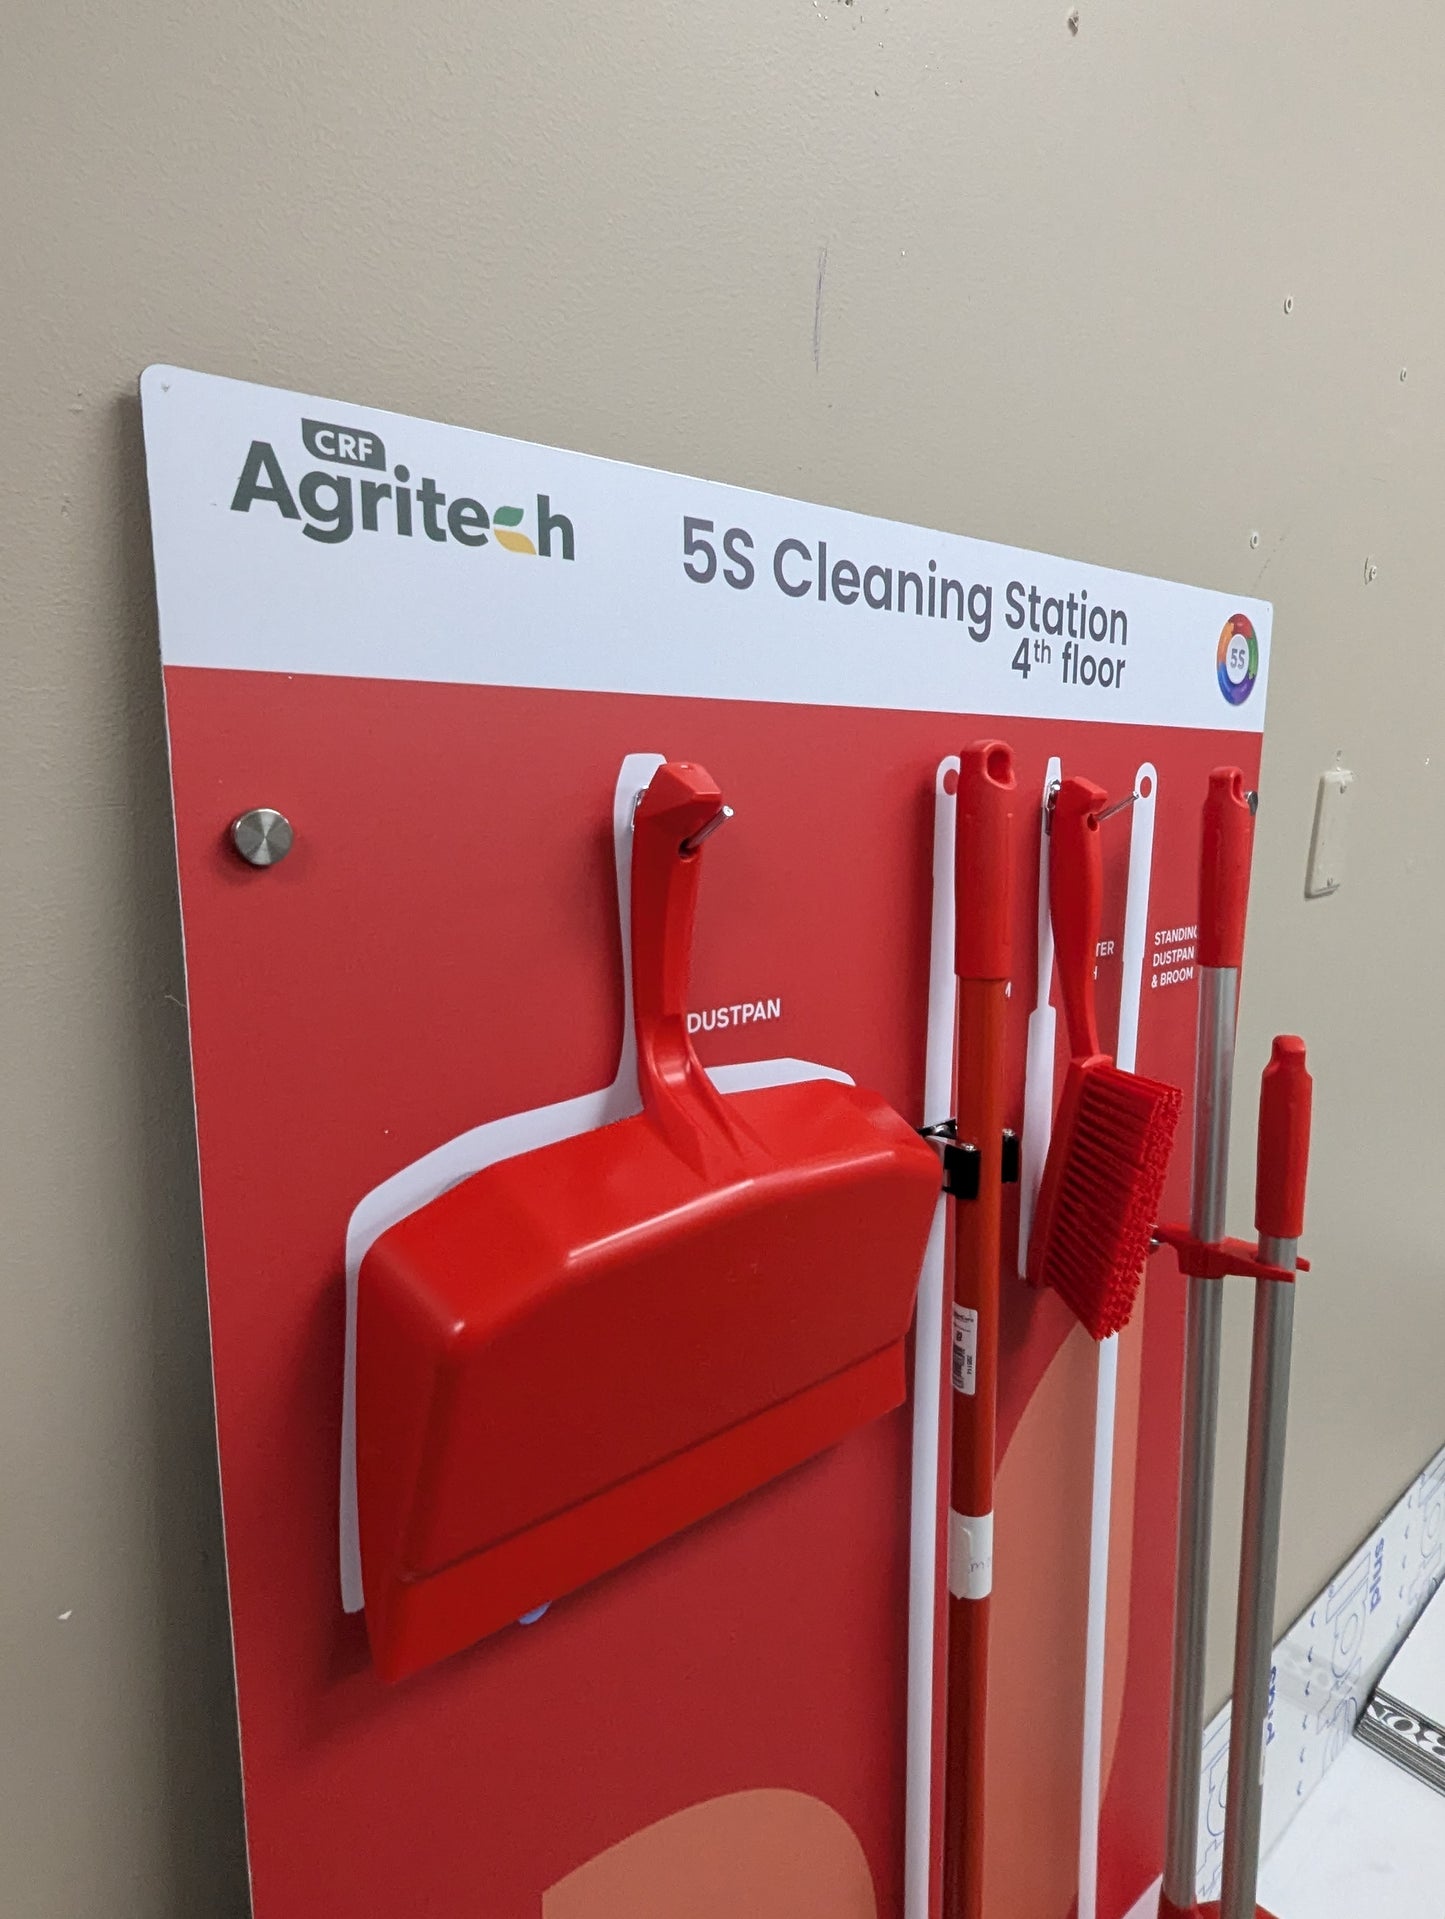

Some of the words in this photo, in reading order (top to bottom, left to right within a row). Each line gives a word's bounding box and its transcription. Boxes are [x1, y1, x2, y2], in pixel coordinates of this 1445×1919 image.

[314, 429, 374, 462] CRF
[683, 515, 756, 590] 5S
[773, 537, 992, 645] Cleaning
[1005, 580, 1127, 646] Station
[1062, 641, 1126, 689] floor
[1229, 646, 1247, 670] 5S
[1152, 945, 1195, 967] DUSTPAN
[1151, 974, 1158, 989] &
[1160, 966, 1194, 986] BROOM
[687, 998, 780, 1034] DUSTPAN
